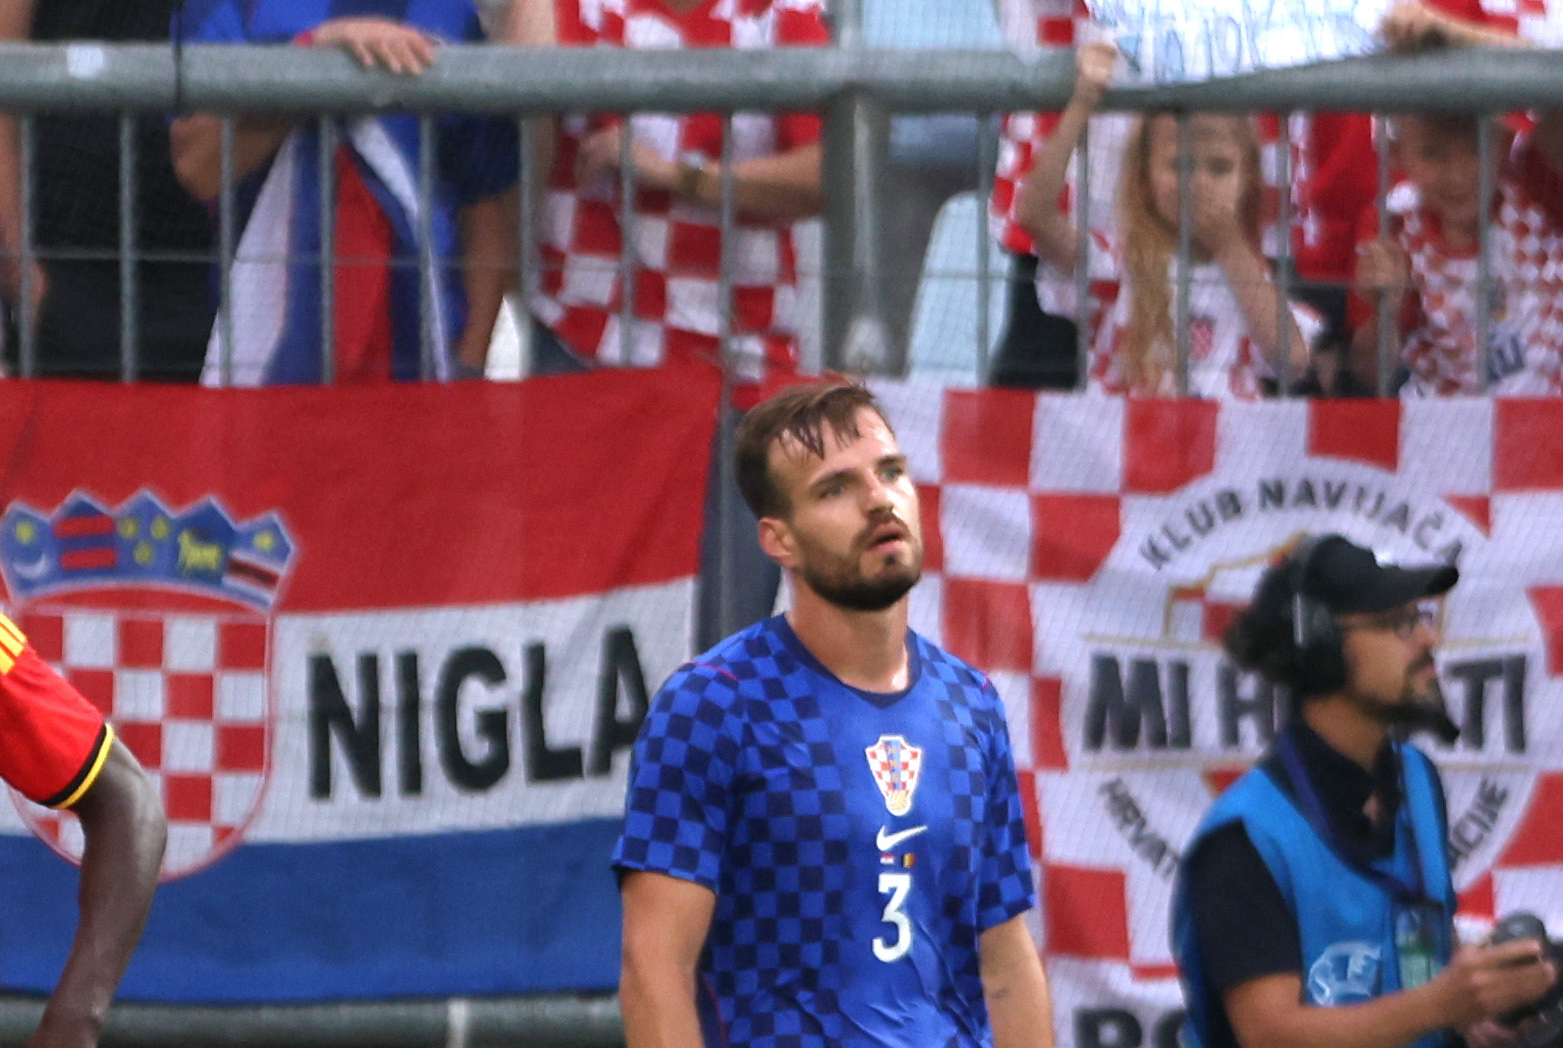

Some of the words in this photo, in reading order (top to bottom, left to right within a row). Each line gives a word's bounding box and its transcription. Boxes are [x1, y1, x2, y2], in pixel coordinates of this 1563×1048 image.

[1139, 488, 1243, 570] KLUB
[306, 623, 651, 801] NIGLA
[1082, 651, 1193, 751] MI
[871, 872, 913, 963] 3
